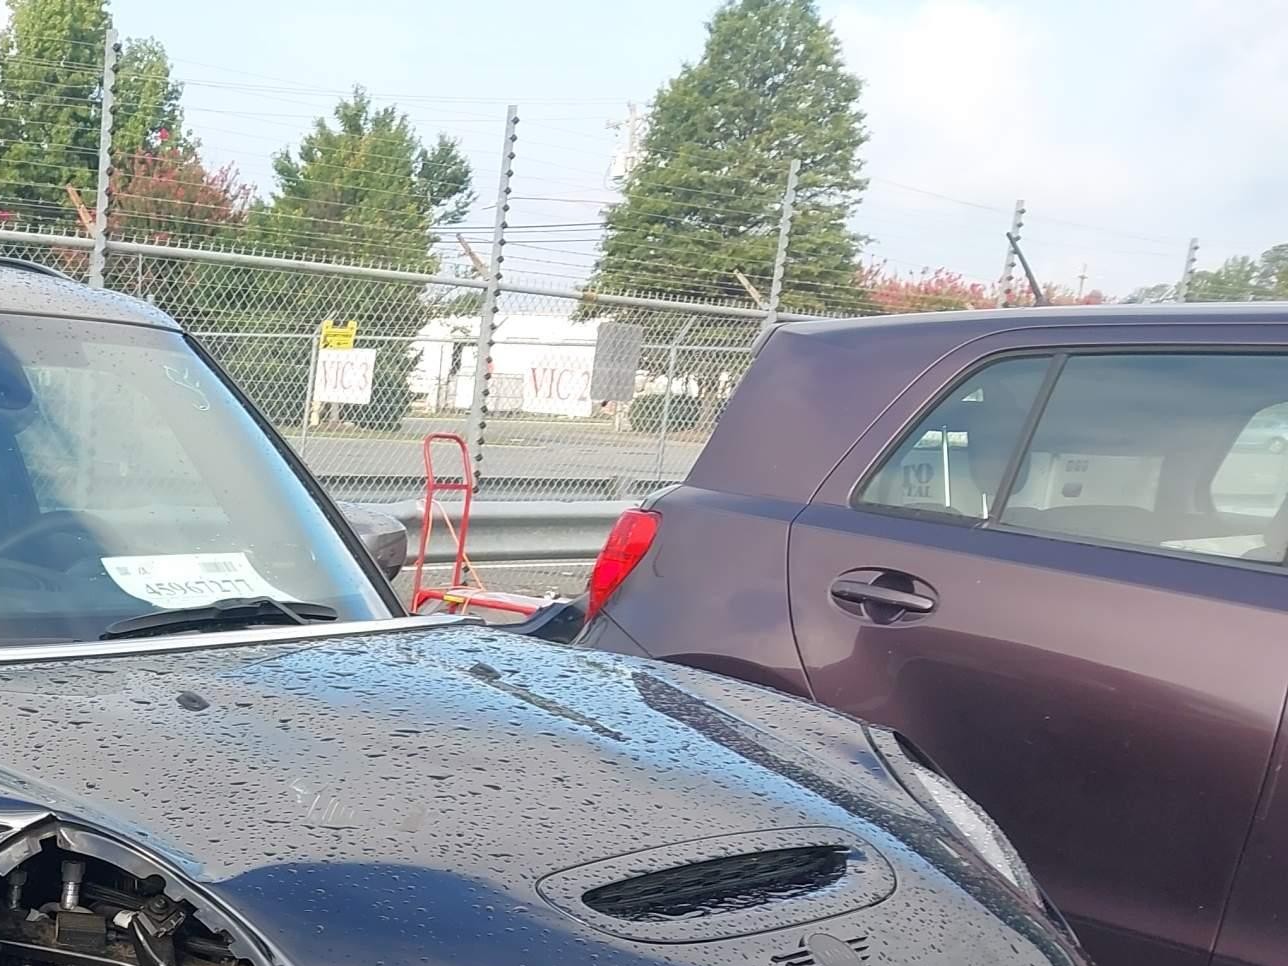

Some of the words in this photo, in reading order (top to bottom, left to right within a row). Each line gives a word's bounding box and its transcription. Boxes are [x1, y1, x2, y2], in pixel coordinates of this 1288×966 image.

[321, 360, 354, 391] VIC
[359, 361, 369, 391] 3
[530, 367, 571, 401] VIC
[578, 370, 591, 402] 2
[144, 579, 255, 597] 45967277
